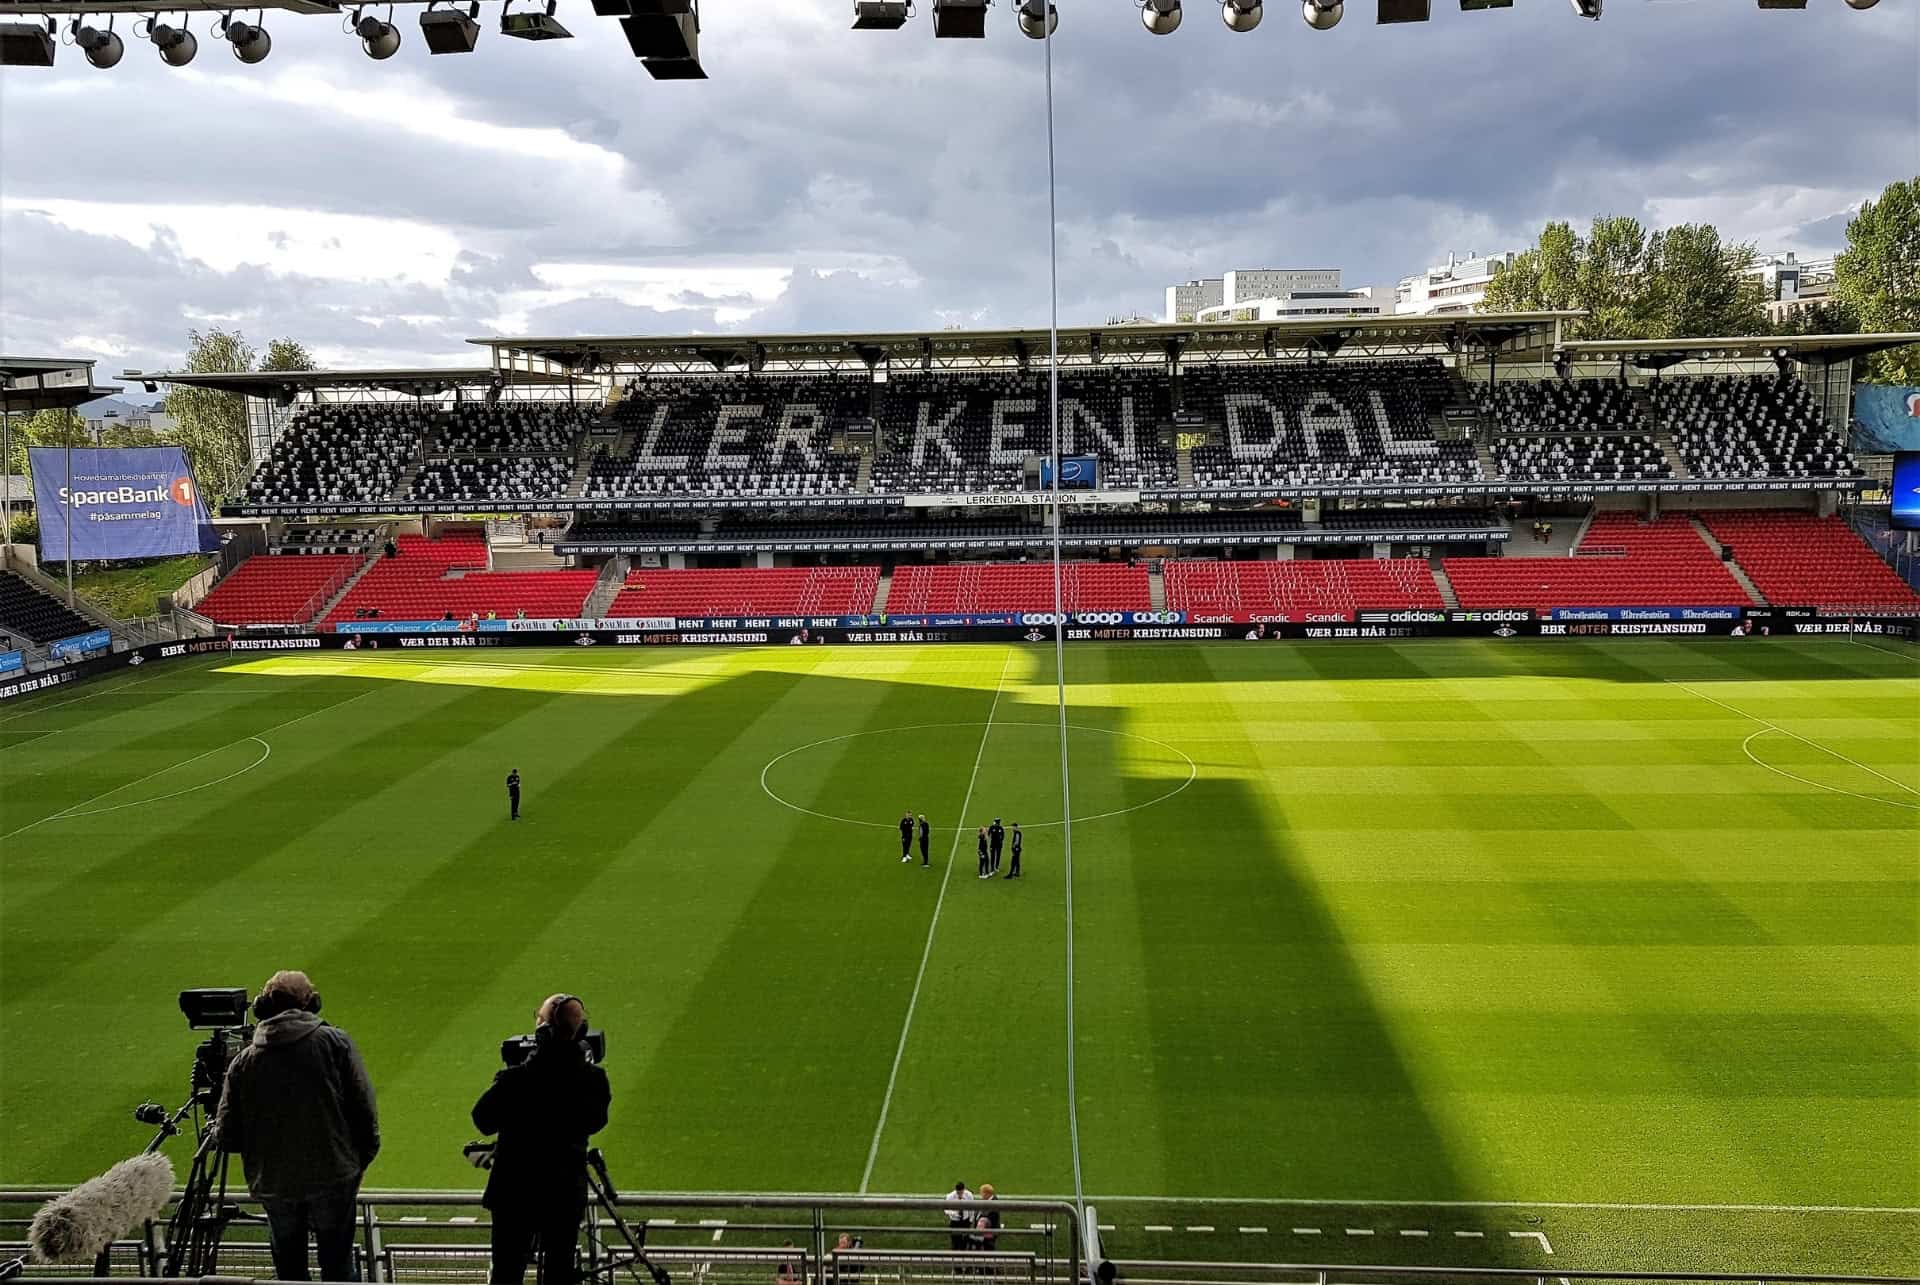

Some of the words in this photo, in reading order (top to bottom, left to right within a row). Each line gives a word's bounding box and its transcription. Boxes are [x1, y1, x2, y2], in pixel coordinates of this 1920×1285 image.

[59, 485, 169, 508] SpareBank
[179, 482, 190, 500] 1
[1301, 489, 1318, 497] HENT
[1595, 484, 1613, 492] HENT
[1681, 483, 1700, 491] HENT
[1747, 482, 1766, 490] HENT
[966, 495, 1027, 505] LERKENDAL
[89, 510, 162, 522] #påsammelag
[1022, 613, 1067, 625] coop
[1078, 612, 1123, 625] coop
[1193, 614, 1234, 624] Scandic
[1249, 613, 1290, 623] Scandic
[1305, 613, 1346, 622] Scandic
[1390, 611, 1436, 622] adidas
[1483, 610, 1529, 621] adidas
[678, 619, 704, 628] HENT
[711, 619, 738, 628] HENT
[745, 619, 771, 628] HENT
[778, 618, 805, 627] HENT
[812, 618, 838, 627] HENT
[1795, 624, 1822, 633] VÆR
[1825, 624, 1850, 633] DER
[1853, 622, 1883, 633] NÅR
[1067, 630, 1091, 639] RBK
[1094, 629, 1129, 638] MØTER
[1133, 628, 1222, 638] KRISTIANSUND
[1305, 628, 1331, 637] VÆR
[1334, 628, 1358, 637] DER
[1361, 625, 1387, 636] NÅR
[1541, 625, 1566, 634] RBK
[1569, 625, 1608, 634] MØTER
[1611, 624, 1706, 633] KRISTIANSUND
[400, 638, 424, 647] VÆR
[427, 638, 449, 647] DER
[452, 635, 477, 646] NÅR
[617, 635, 641, 643] RBK
[644, 635, 679, 643] MØTER
[682, 633, 768, 643] KRISTIANSUND
[848, 633, 872, 642] VÆR
[875, 633, 896, 641] DER
[899, 630, 924, 641] NÅR
[161, 644, 186, 658] RBK
[189, 641, 228, 652] MØTER
[232, 639, 321, 650] KRISTIANSUND
[20, 680, 39, 693] DER
[40, 674, 59, 688] NÅR
